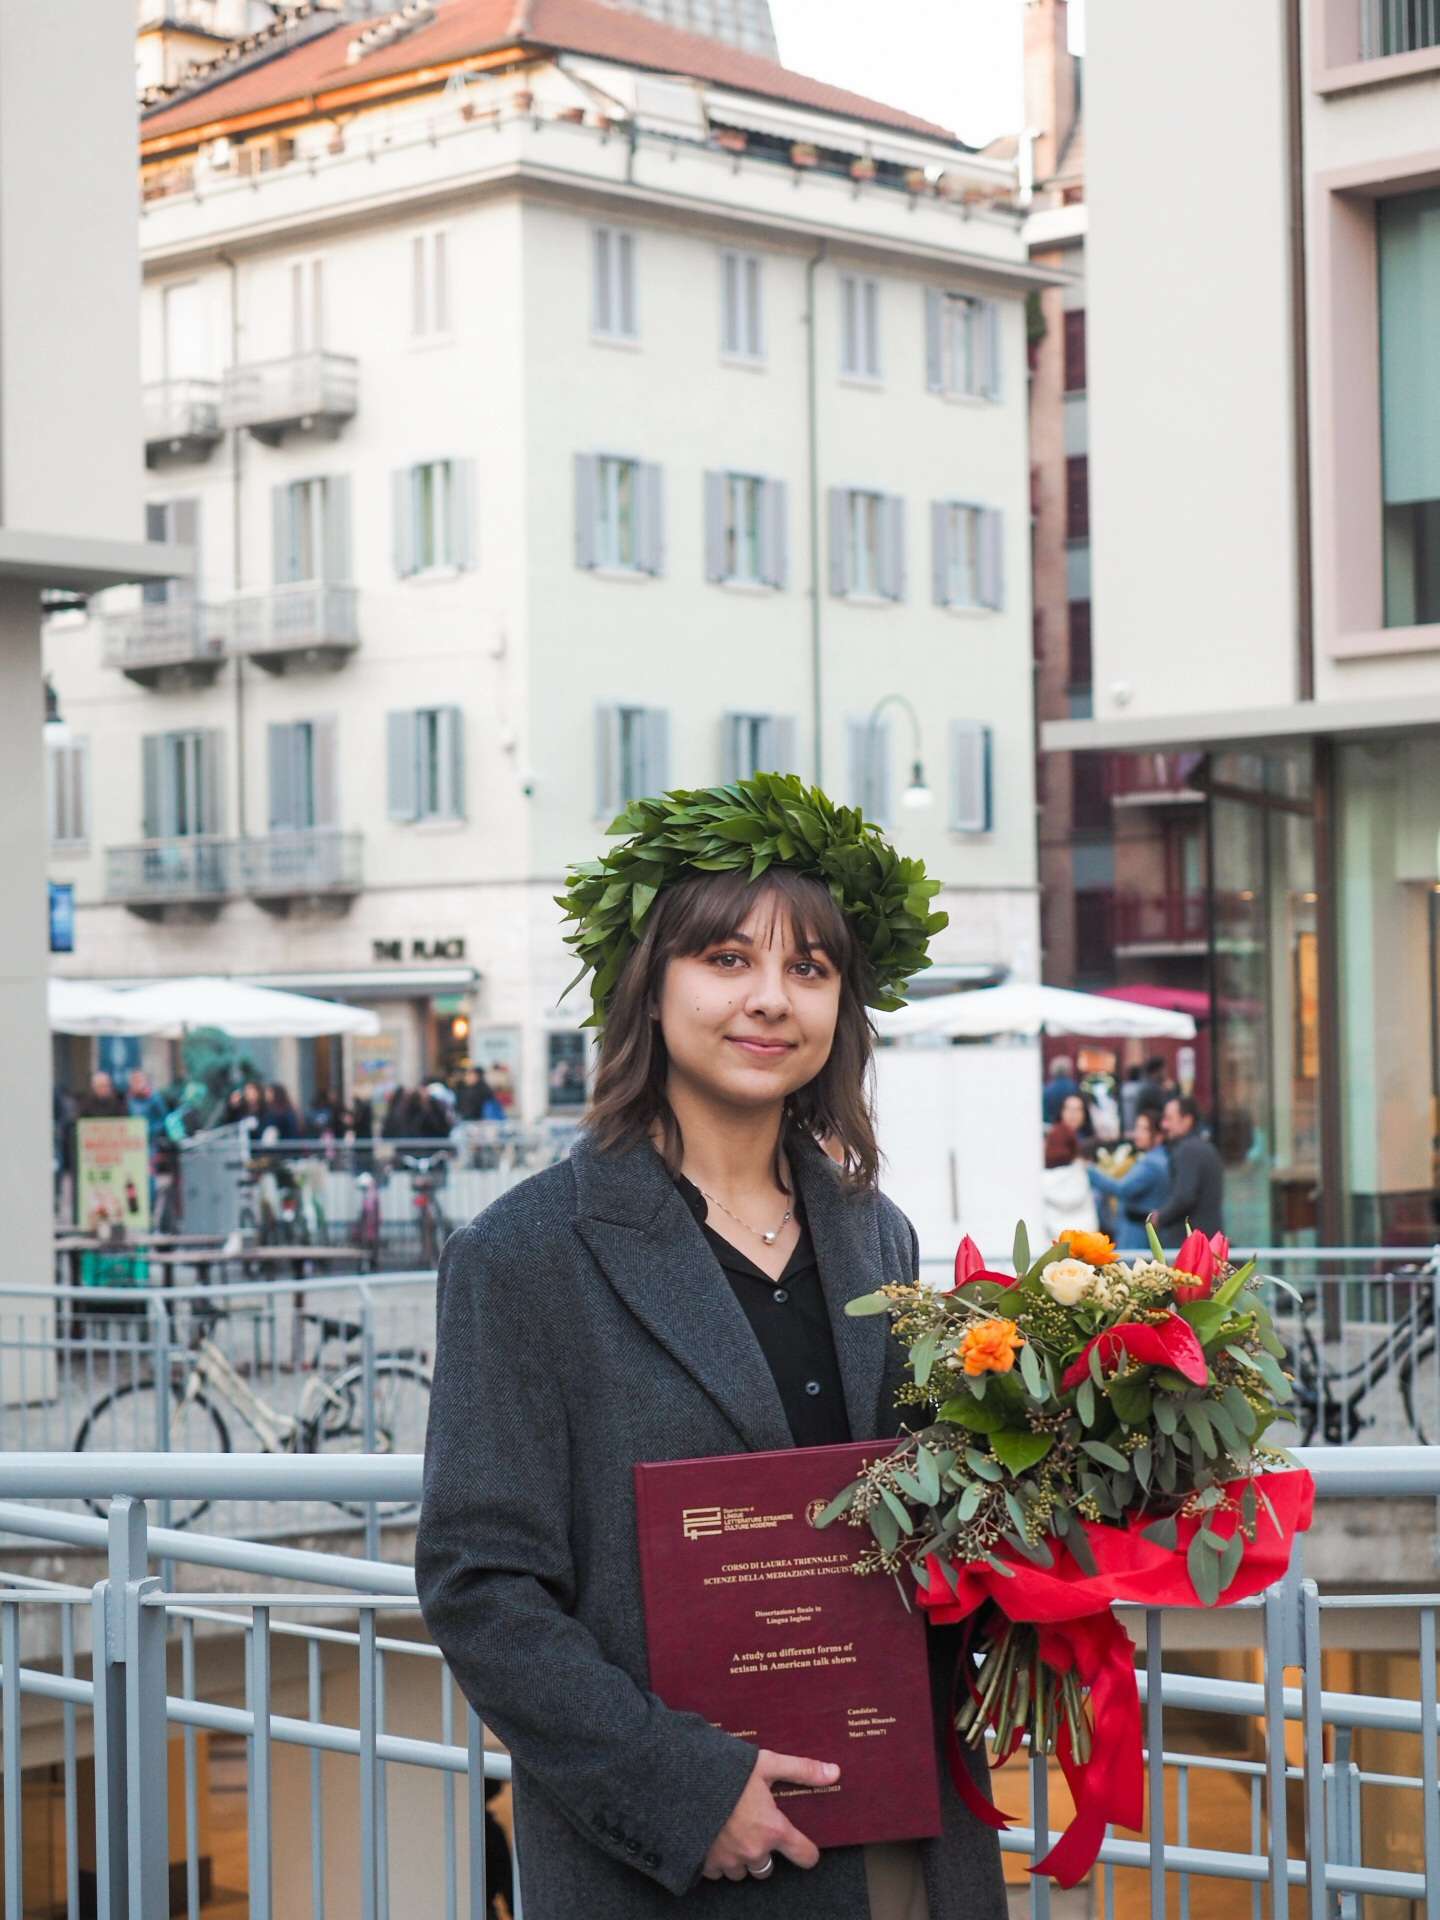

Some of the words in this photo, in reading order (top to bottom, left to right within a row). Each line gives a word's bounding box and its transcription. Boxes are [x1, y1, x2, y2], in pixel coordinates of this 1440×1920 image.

[373, 939, 402, 962] THE
[412, 938, 466, 961] PLACE
[721, 1563, 749, 1572] CORSO
[750, 1562, 759, 1570] DI
[760, 1559, 793, 1569] LAUREA
[793, 1556, 837, 1566] TRIENNALE
[839, 1554, 849, 1562] IN
[703, 1575, 737, 1585] SCIENZE
[738, 1572, 765, 1582] DELLA
[766, 1569, 816, 1579] MEDIAZIONE
[766, 1617, 788, 1625] Lingua
[732, 1653, 740, 1662] A
[742, 1651, 764, 1661] study
[779, 1647, 816, 1657] different
[817, 1645, 842, 1654] forms
[843, 1642, 854, 1651] of
[730, 1665, 758, 1674] sexism
[759, 1663, 768, 1671] in
[770, 1660, 811, 1671] American
[813, 1657, 829, 1666] talk
[831, 1655, 857, 1665] shows
